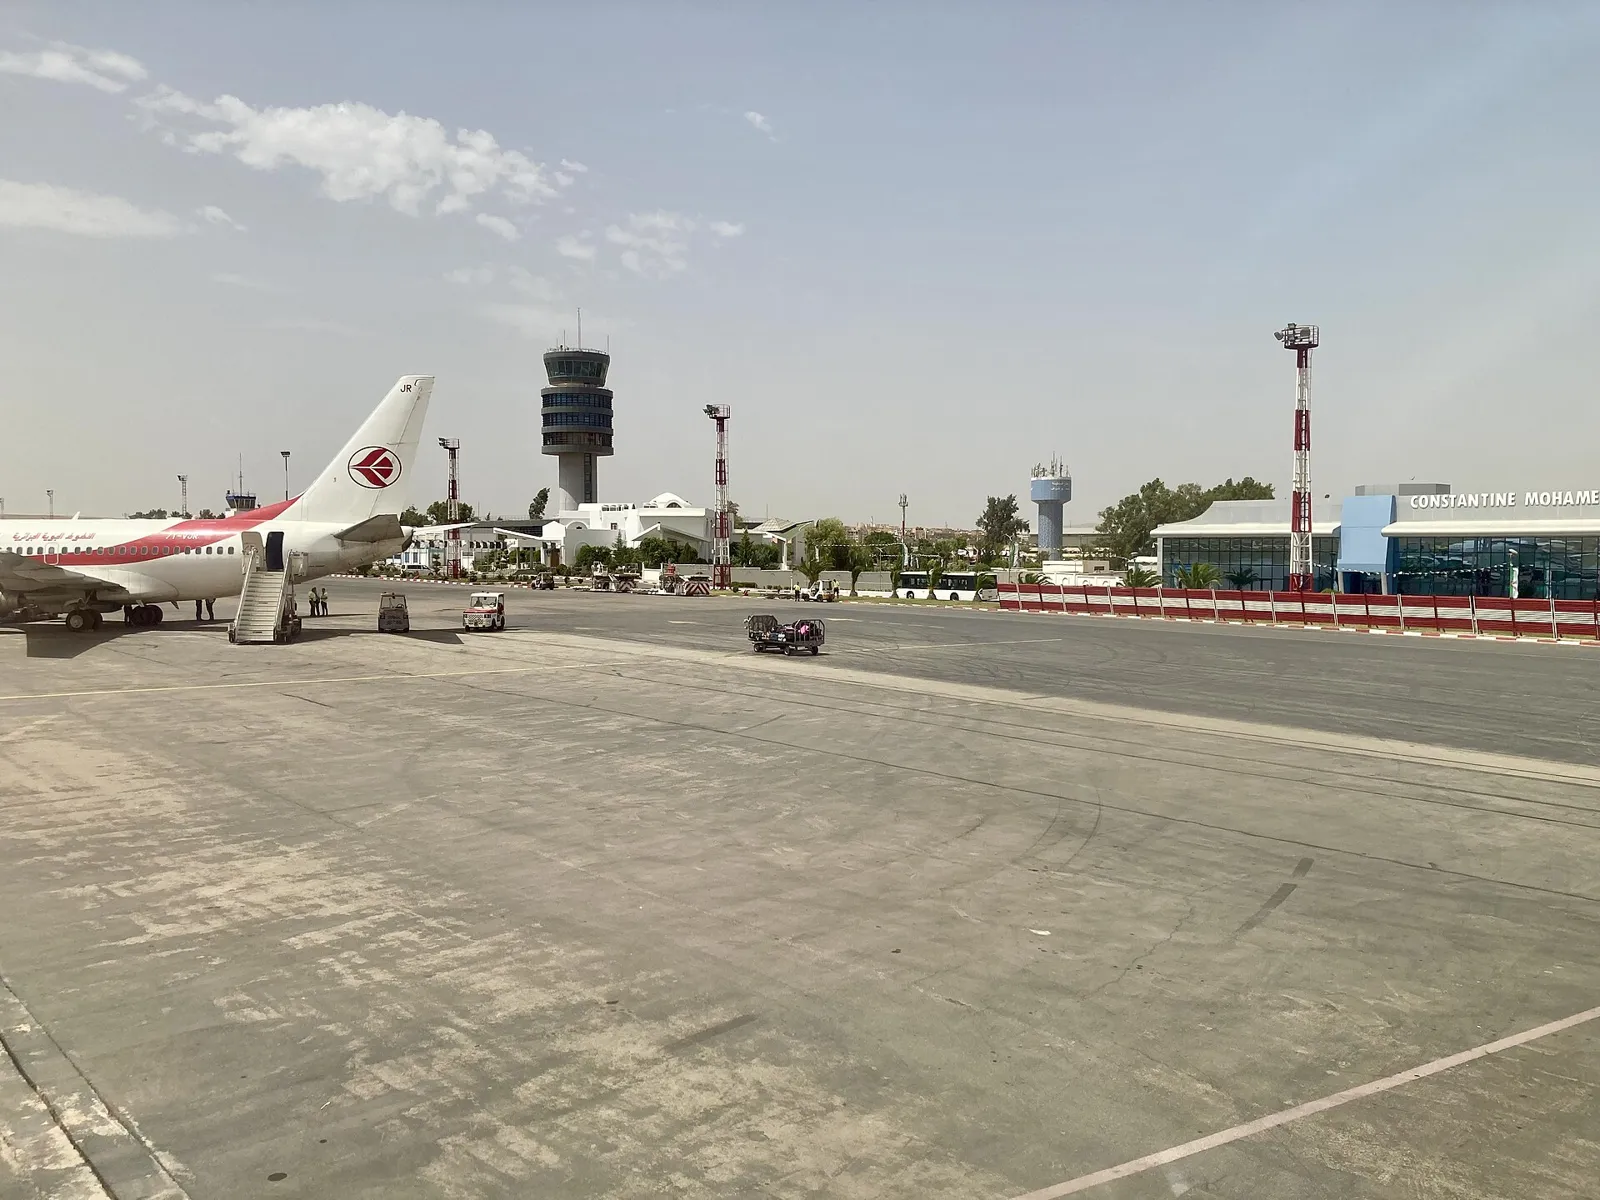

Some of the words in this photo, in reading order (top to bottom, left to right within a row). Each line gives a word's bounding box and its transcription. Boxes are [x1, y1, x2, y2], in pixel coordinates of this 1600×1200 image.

[400, 384, 412, 393] JR
[1410, 492, 1516, 509] CONSTANTINE
[1524, 490, 1600, 506] MOHAME
